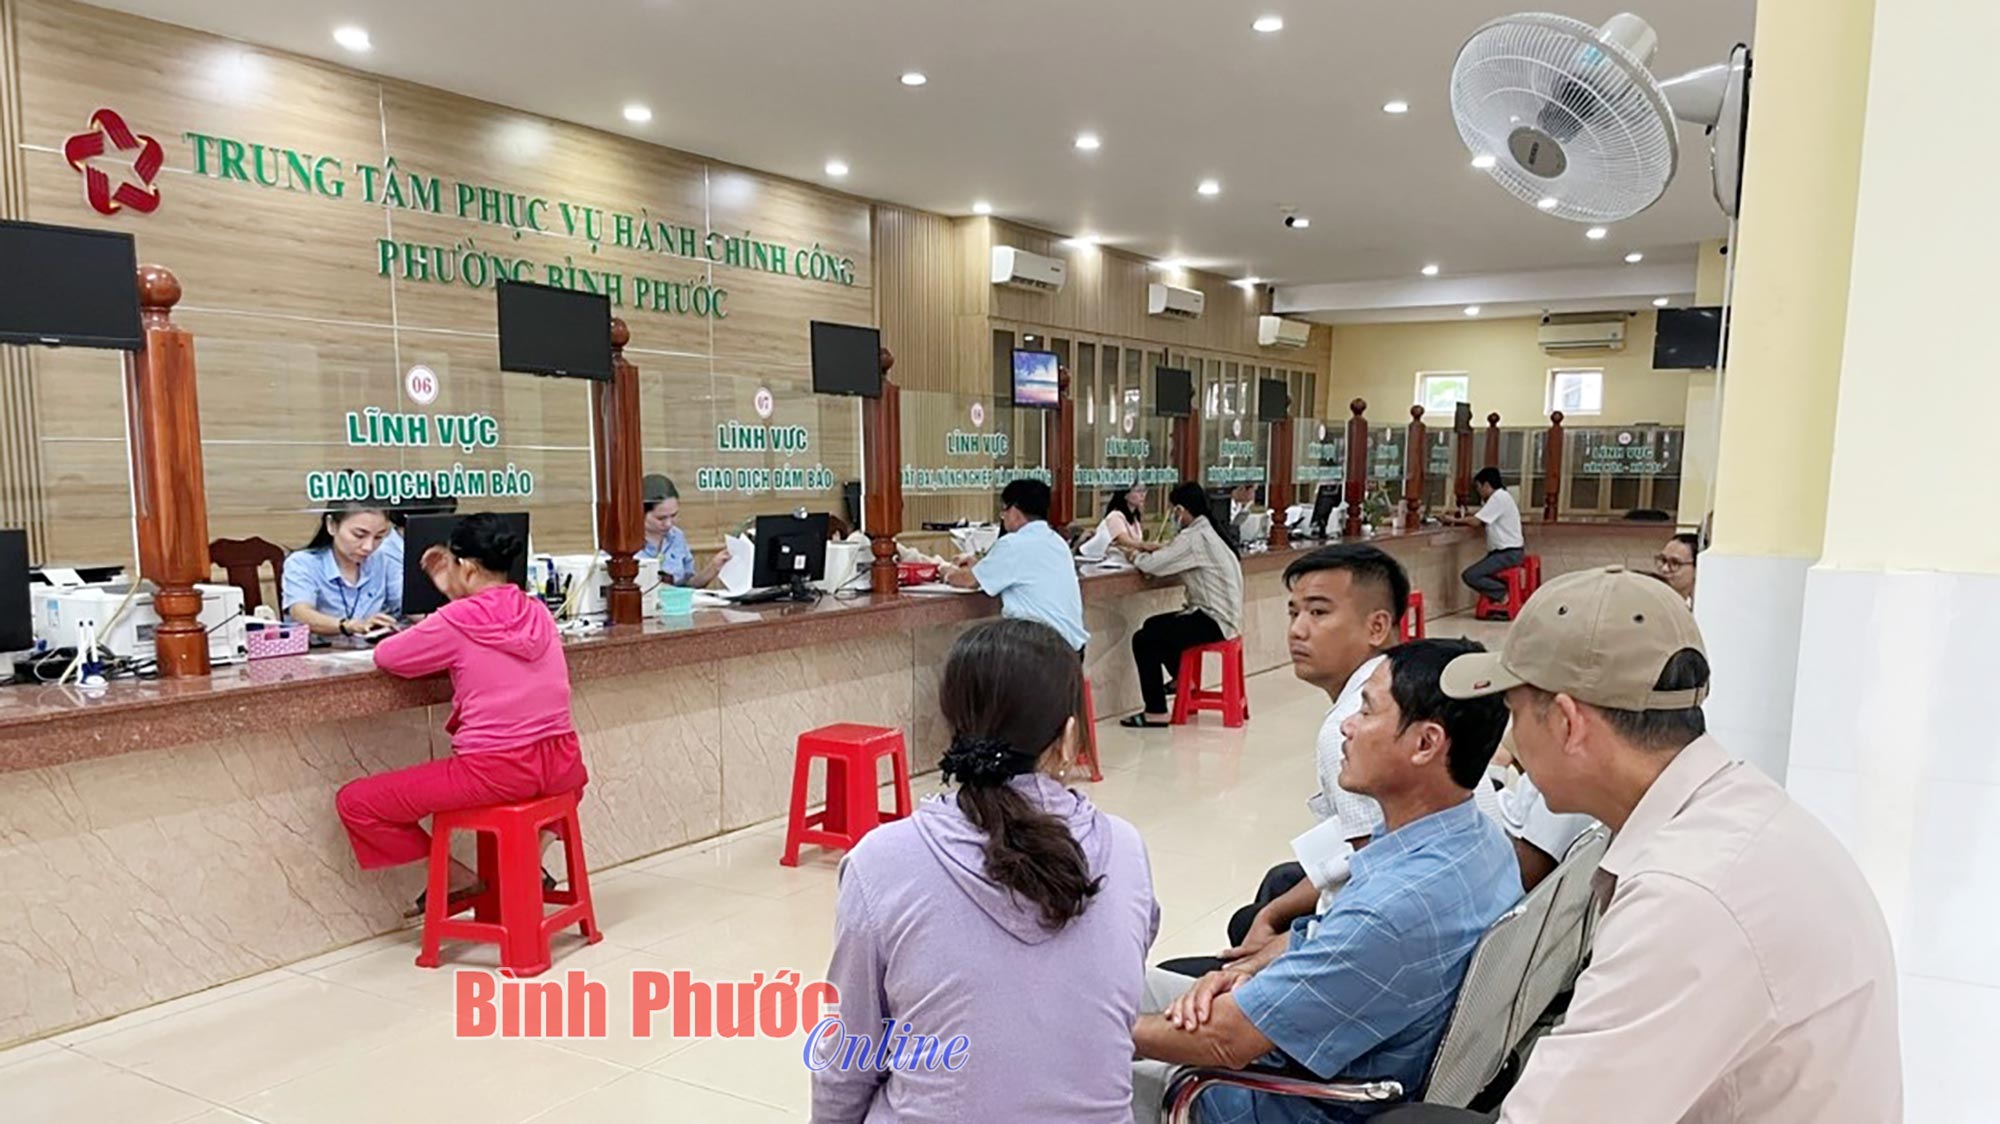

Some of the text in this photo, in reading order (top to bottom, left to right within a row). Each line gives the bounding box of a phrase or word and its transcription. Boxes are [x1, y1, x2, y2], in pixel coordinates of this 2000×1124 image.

[184, 130, 857, 287] TRUNG TÂM PHỤC VỤ HÀNH CHÍNH CÔNG
[377, 237, 729, 320] PHƯỜNG BÌNH PHƯỚC
[411, 375, 433, 395] 06
[346, 407, 500, 452] LĨNH VỰC
[717, 420, 809, 456] LĨNH VỰC
[947, 429, 1010, 460] LĨNH VỰC
[307, 462, 534, 505] GIAO DỊCH ĐẢM BẢO
[696, 463, 835, 496] GIAO DỊCH ĐẢM BẢO
